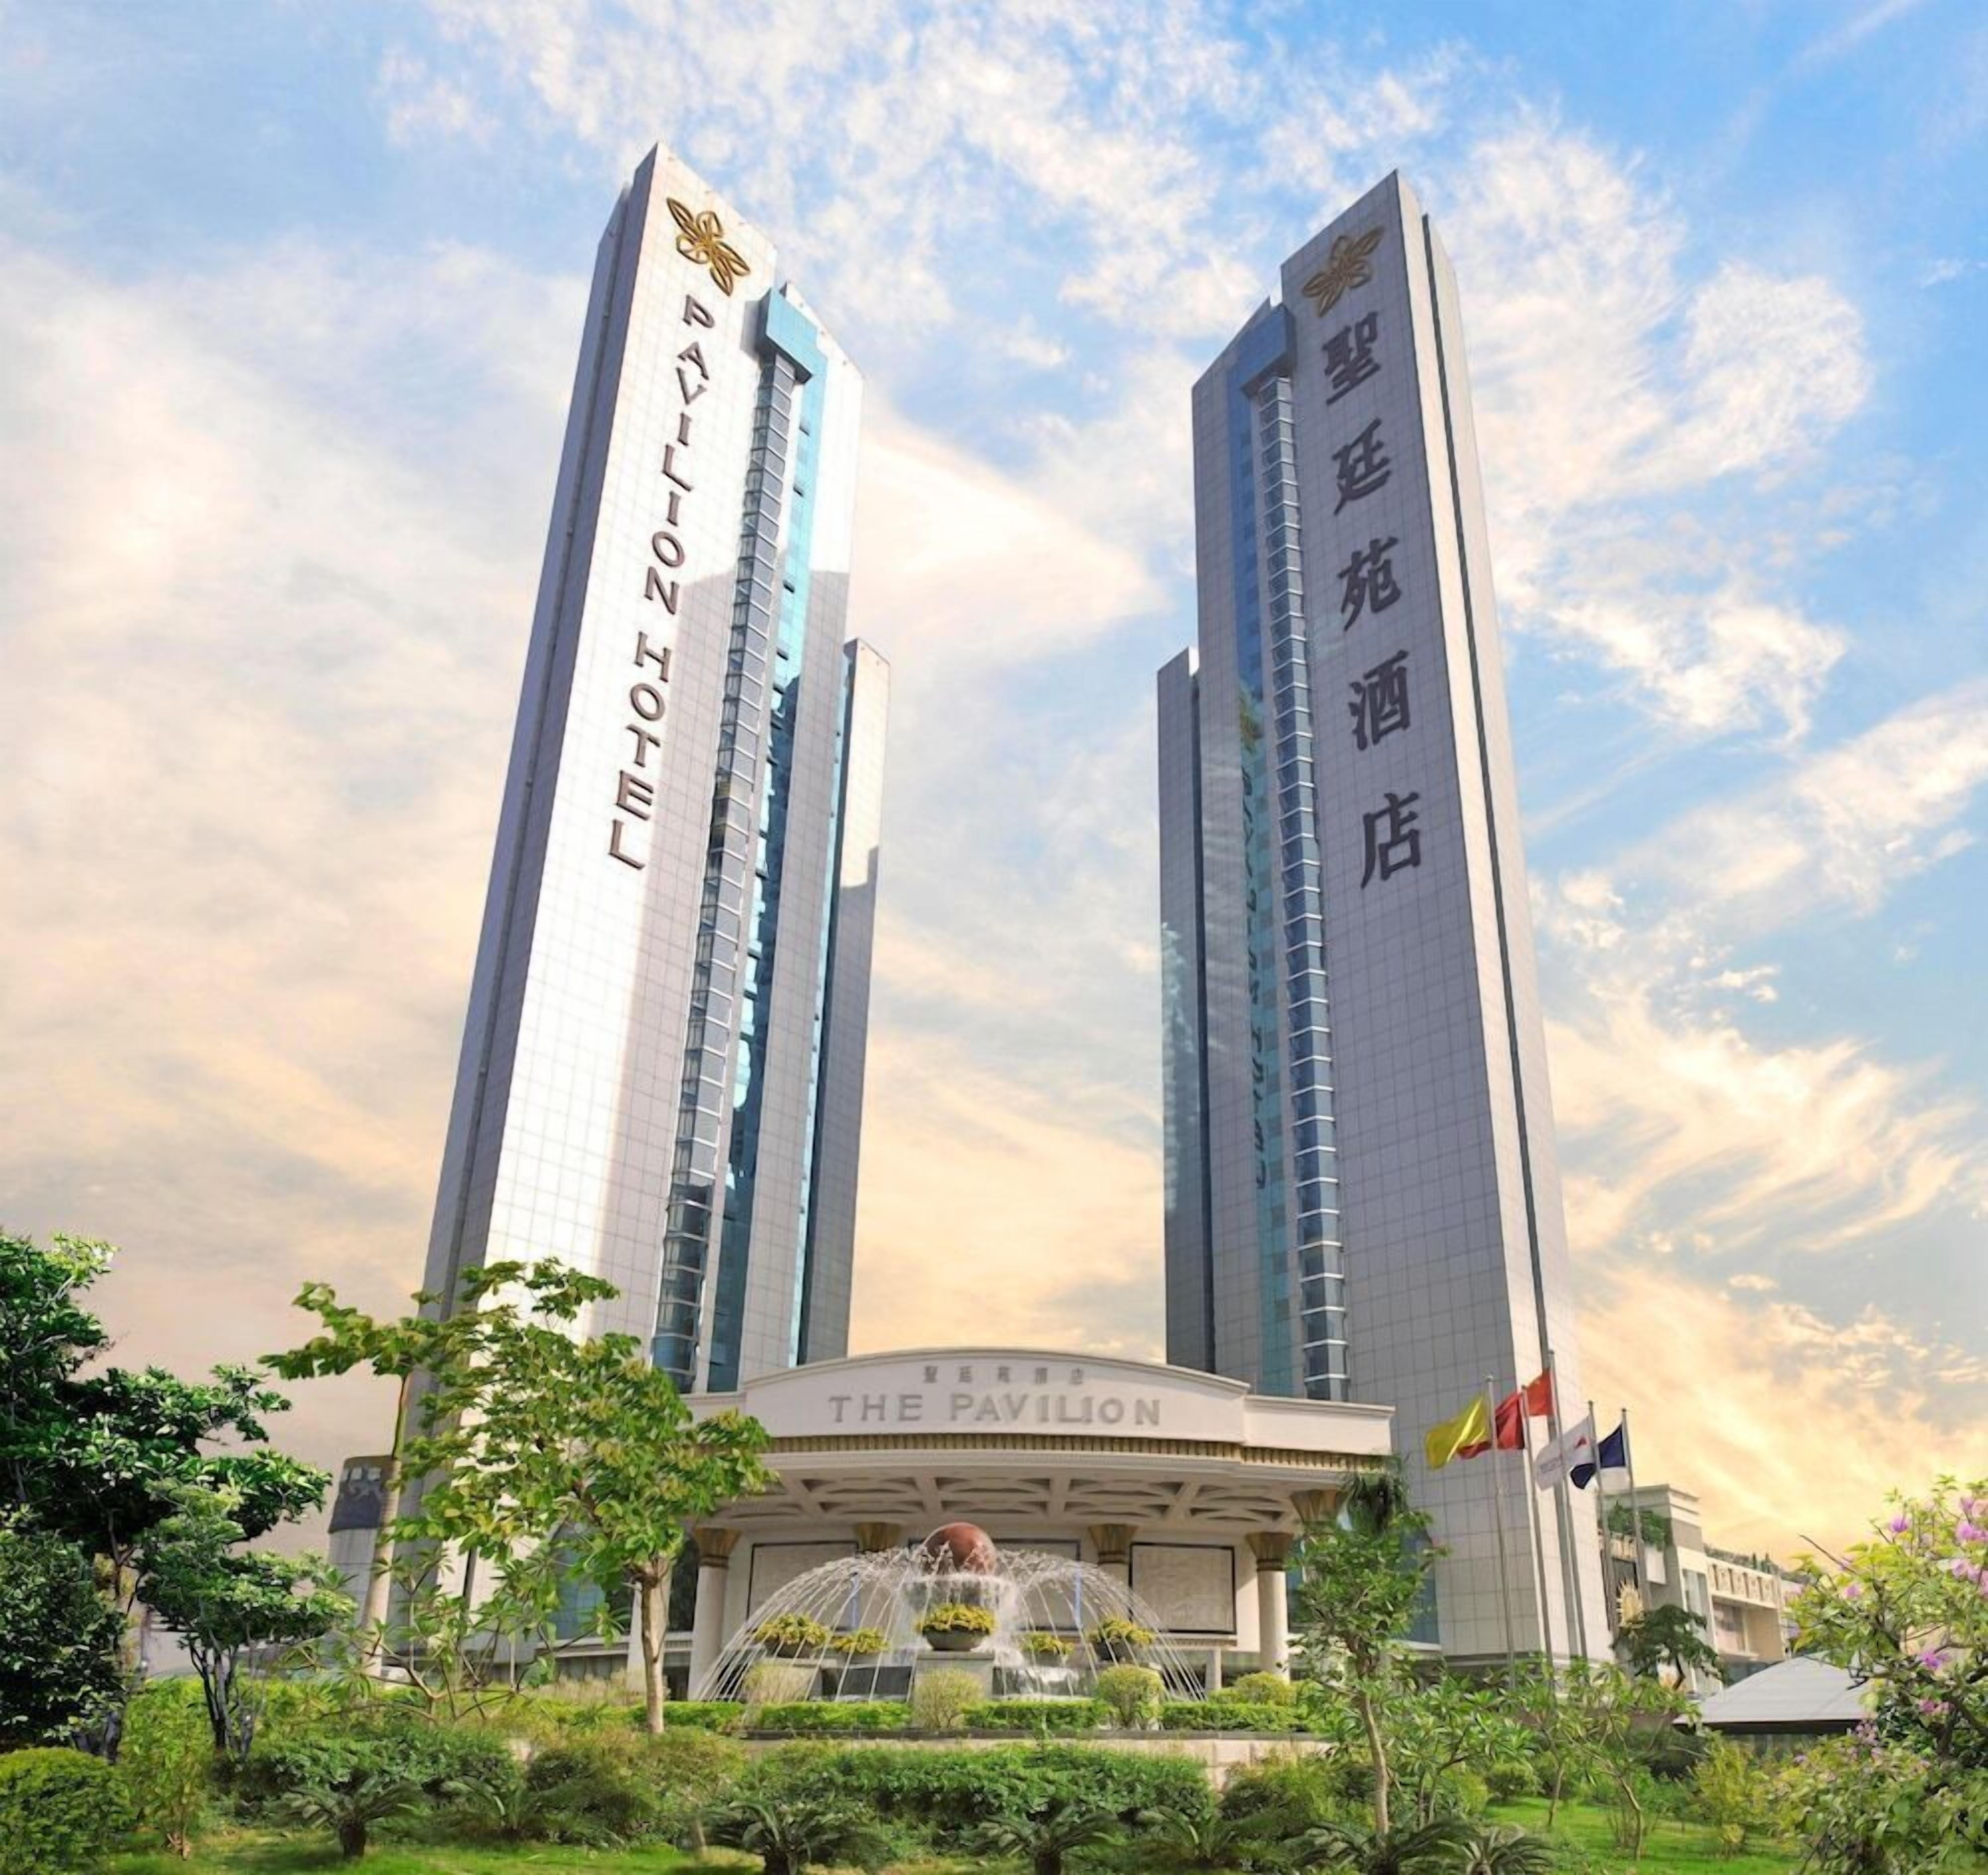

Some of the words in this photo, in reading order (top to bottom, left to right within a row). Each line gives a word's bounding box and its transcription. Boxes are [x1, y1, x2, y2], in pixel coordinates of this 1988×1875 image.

[645, 295, 715, 615] PAVILION
[1320, 311, 1420, 889] 聖廷苑酒店
[608, 631, 671, 869] HOTEL
[828, 1395, 923, 1423] THE
[949, 1393, 1160, 1426] PAVILION
